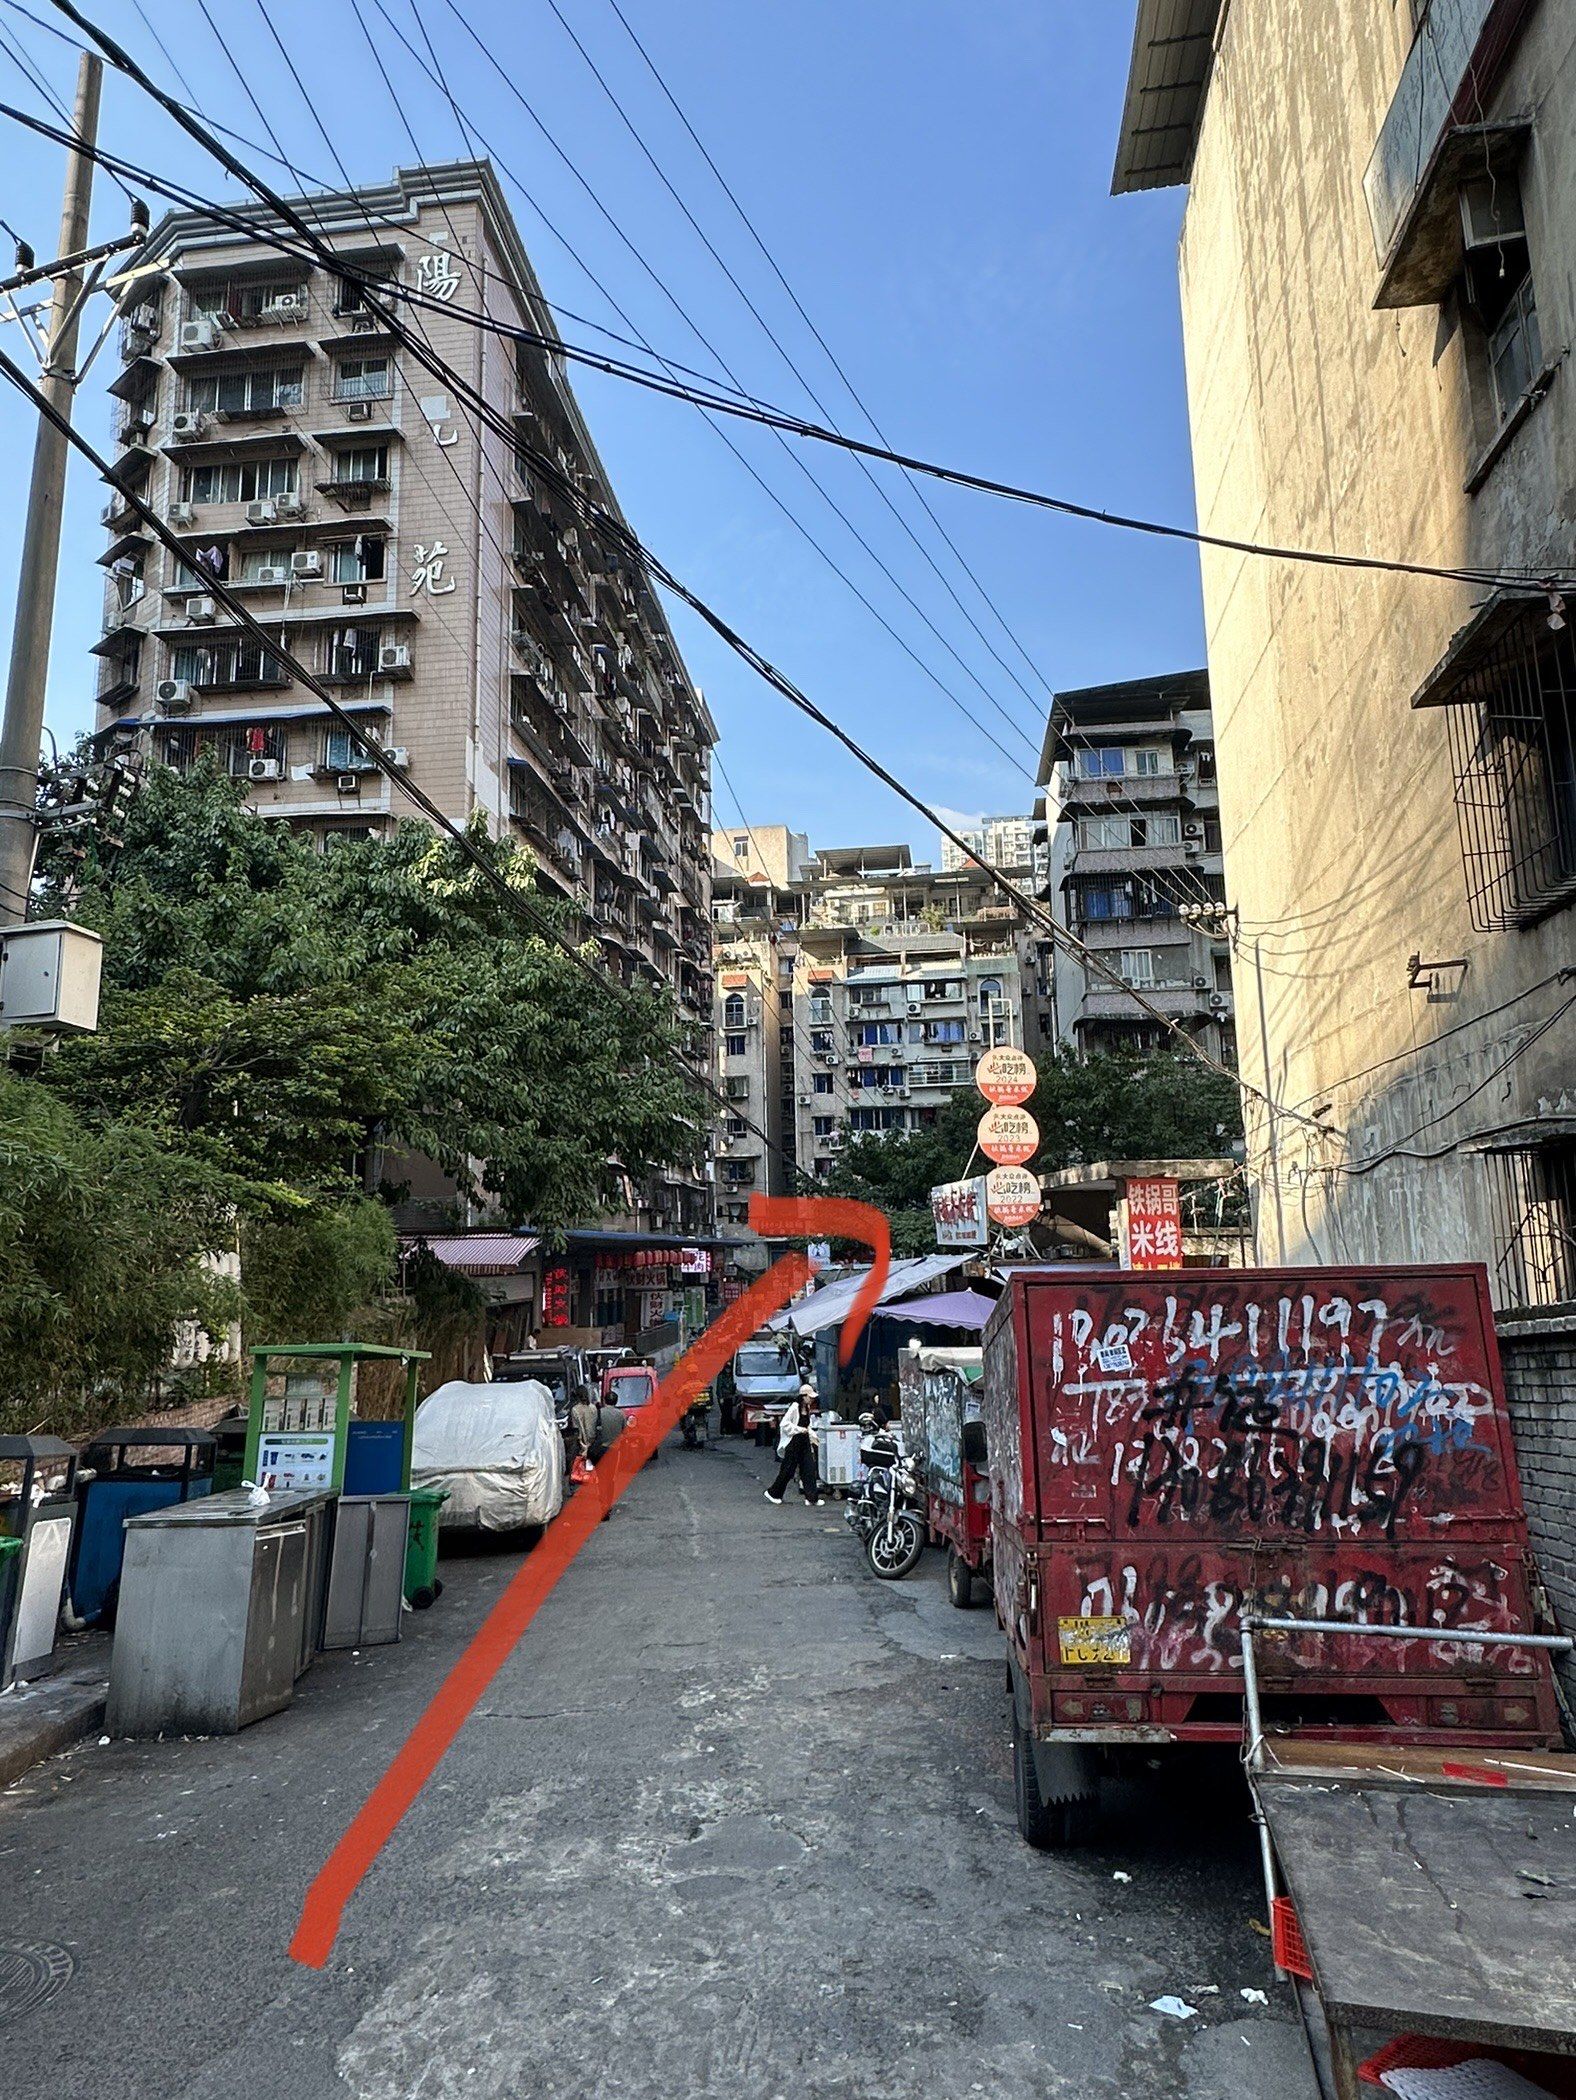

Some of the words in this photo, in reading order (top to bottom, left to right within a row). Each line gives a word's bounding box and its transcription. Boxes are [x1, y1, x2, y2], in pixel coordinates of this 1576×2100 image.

[1002, 1172, 1028, 1180] 大众点评
[1000, 1196, 1023, 1204] 2022
[1129, 1184, 1178, 1216] 铁锅哥
[1131, 1220, 1179, 1258] 米线
